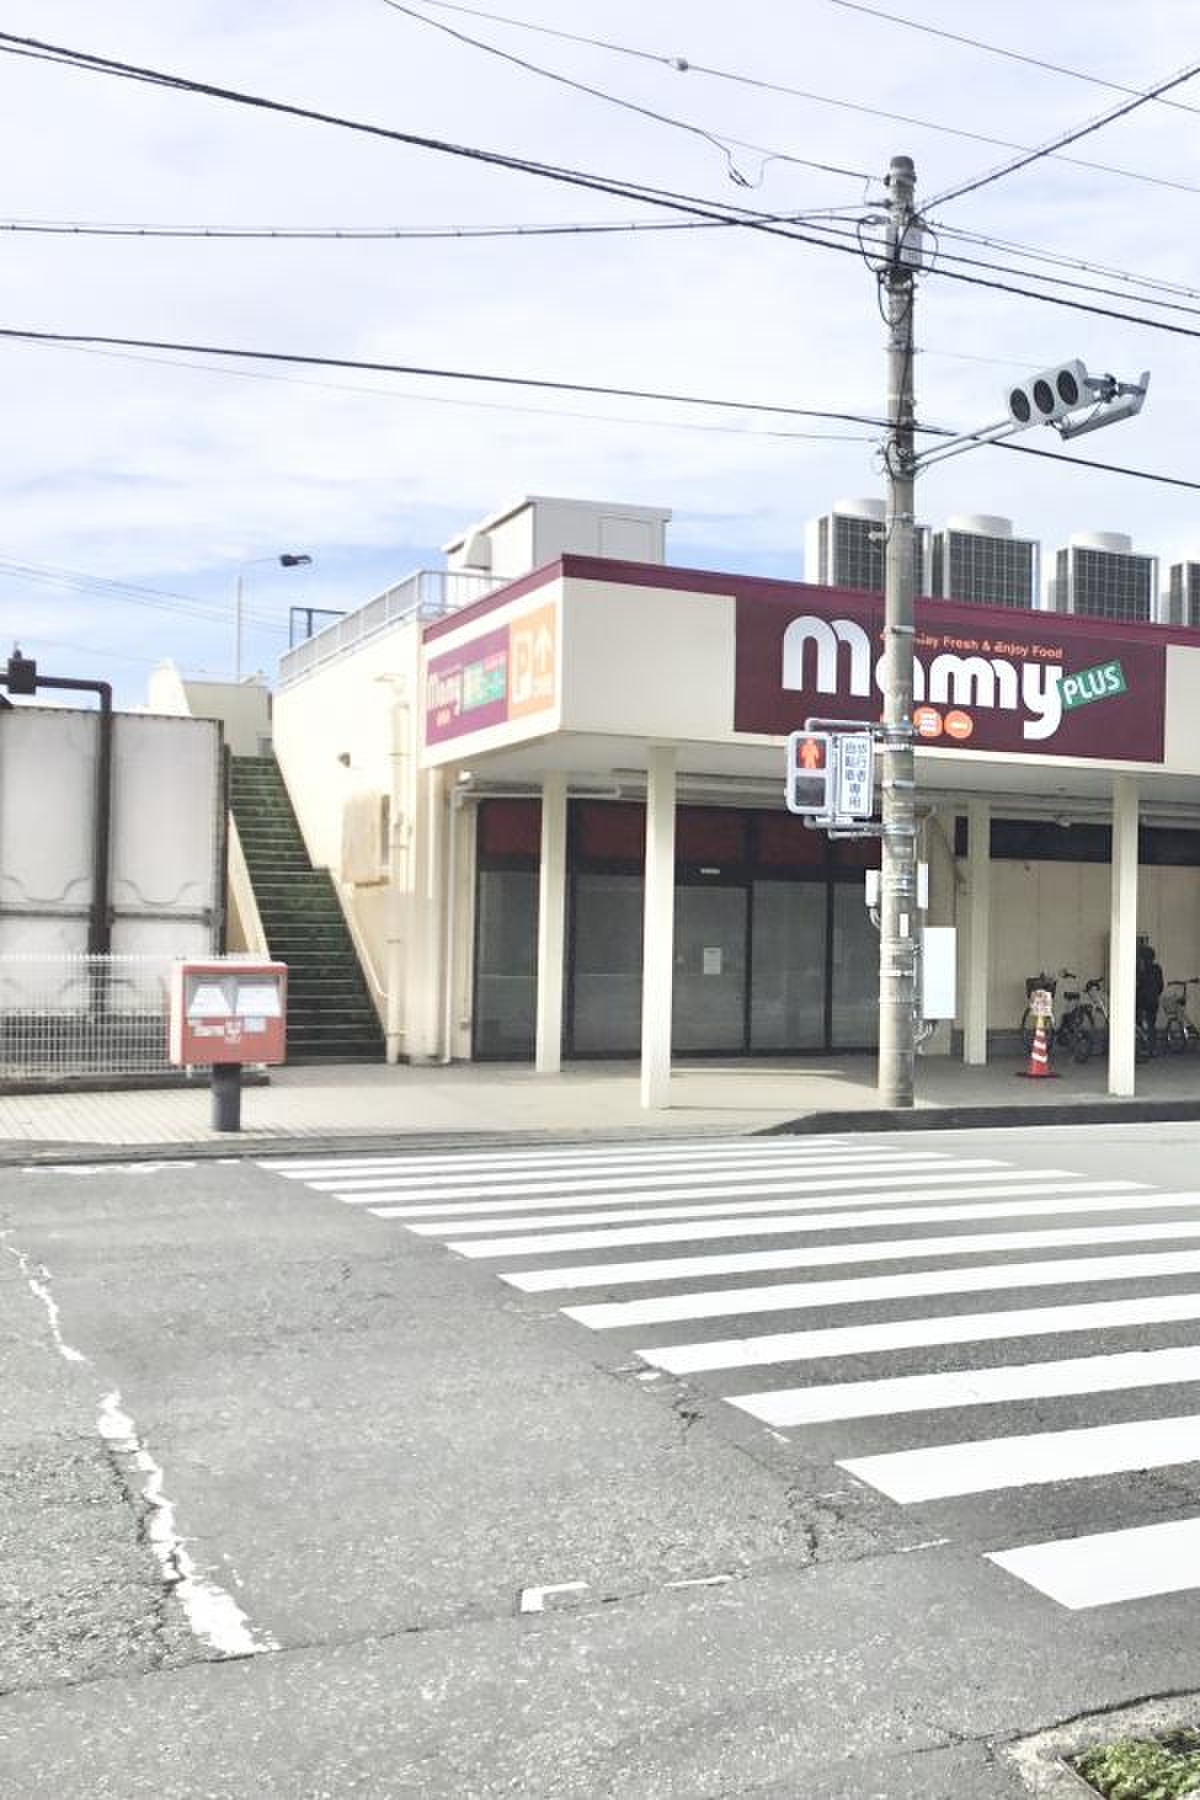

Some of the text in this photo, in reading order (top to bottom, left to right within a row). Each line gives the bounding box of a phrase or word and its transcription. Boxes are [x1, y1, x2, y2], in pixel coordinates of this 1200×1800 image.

[943, 636, 978, 650] Fresh
[981, 640, 991, 651] &
[994, 641, 1028, 657] Enjoy
[1032, 645, 1062, 659] Food
[1063, 665, 1121, 705] PLUS
